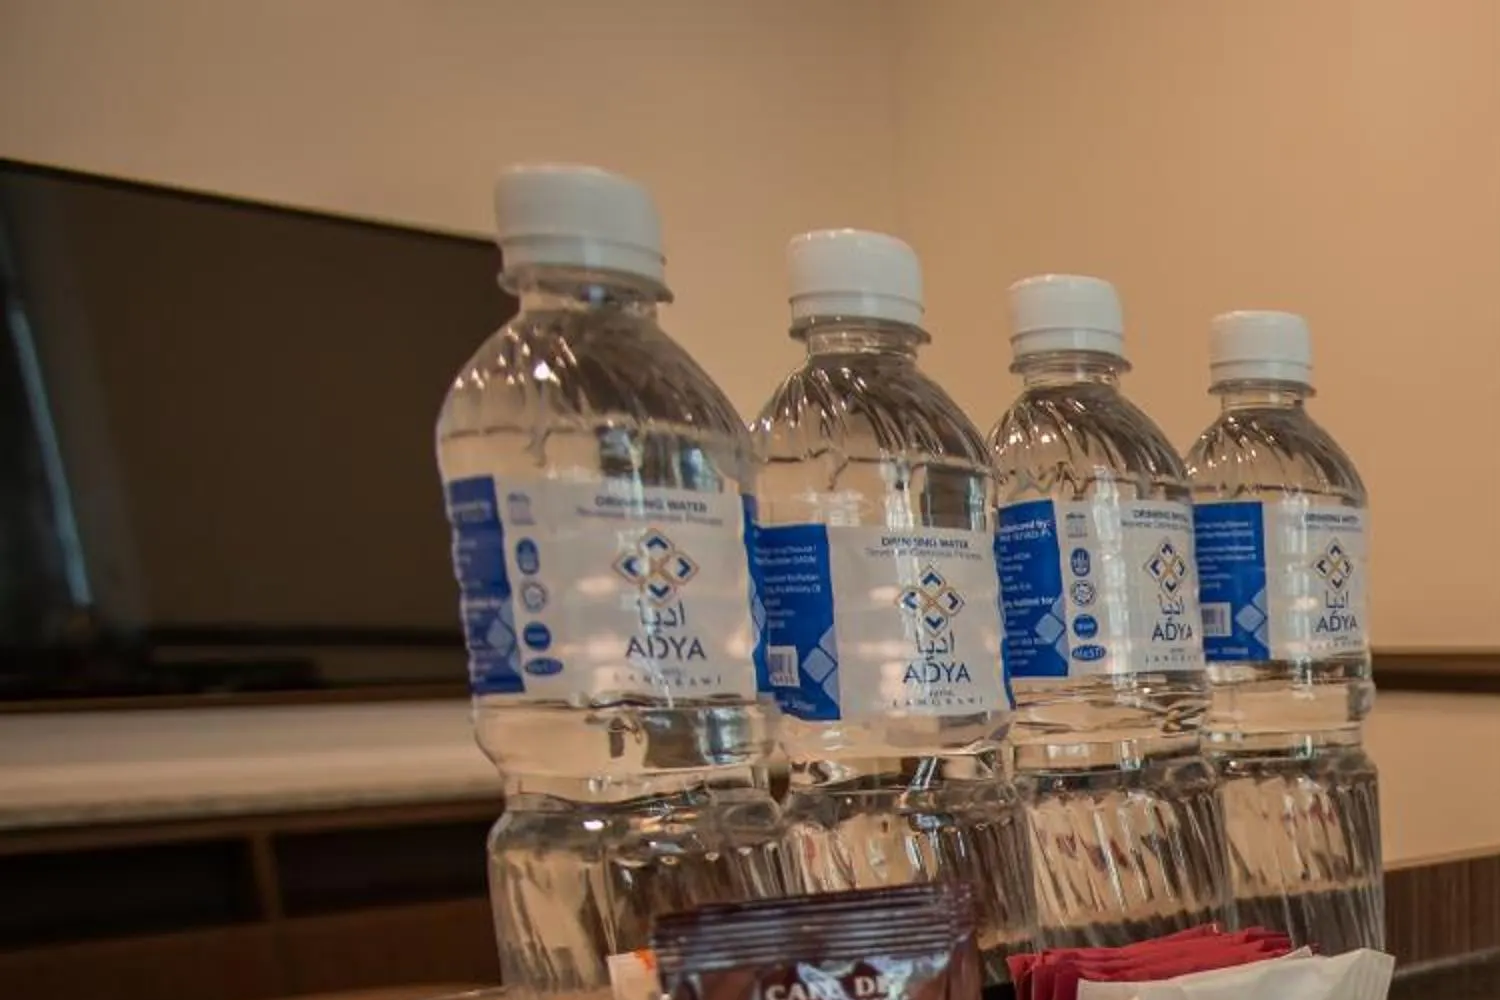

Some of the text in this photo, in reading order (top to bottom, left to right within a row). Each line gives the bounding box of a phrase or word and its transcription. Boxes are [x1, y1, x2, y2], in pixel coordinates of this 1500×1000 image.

[1151, 621, 1193, 642] ADYA
[1315, 614, 1358, 633] ADYA
[624, 634, 707, 660] ADYA
[902, 660, 972, 684] ADYA
